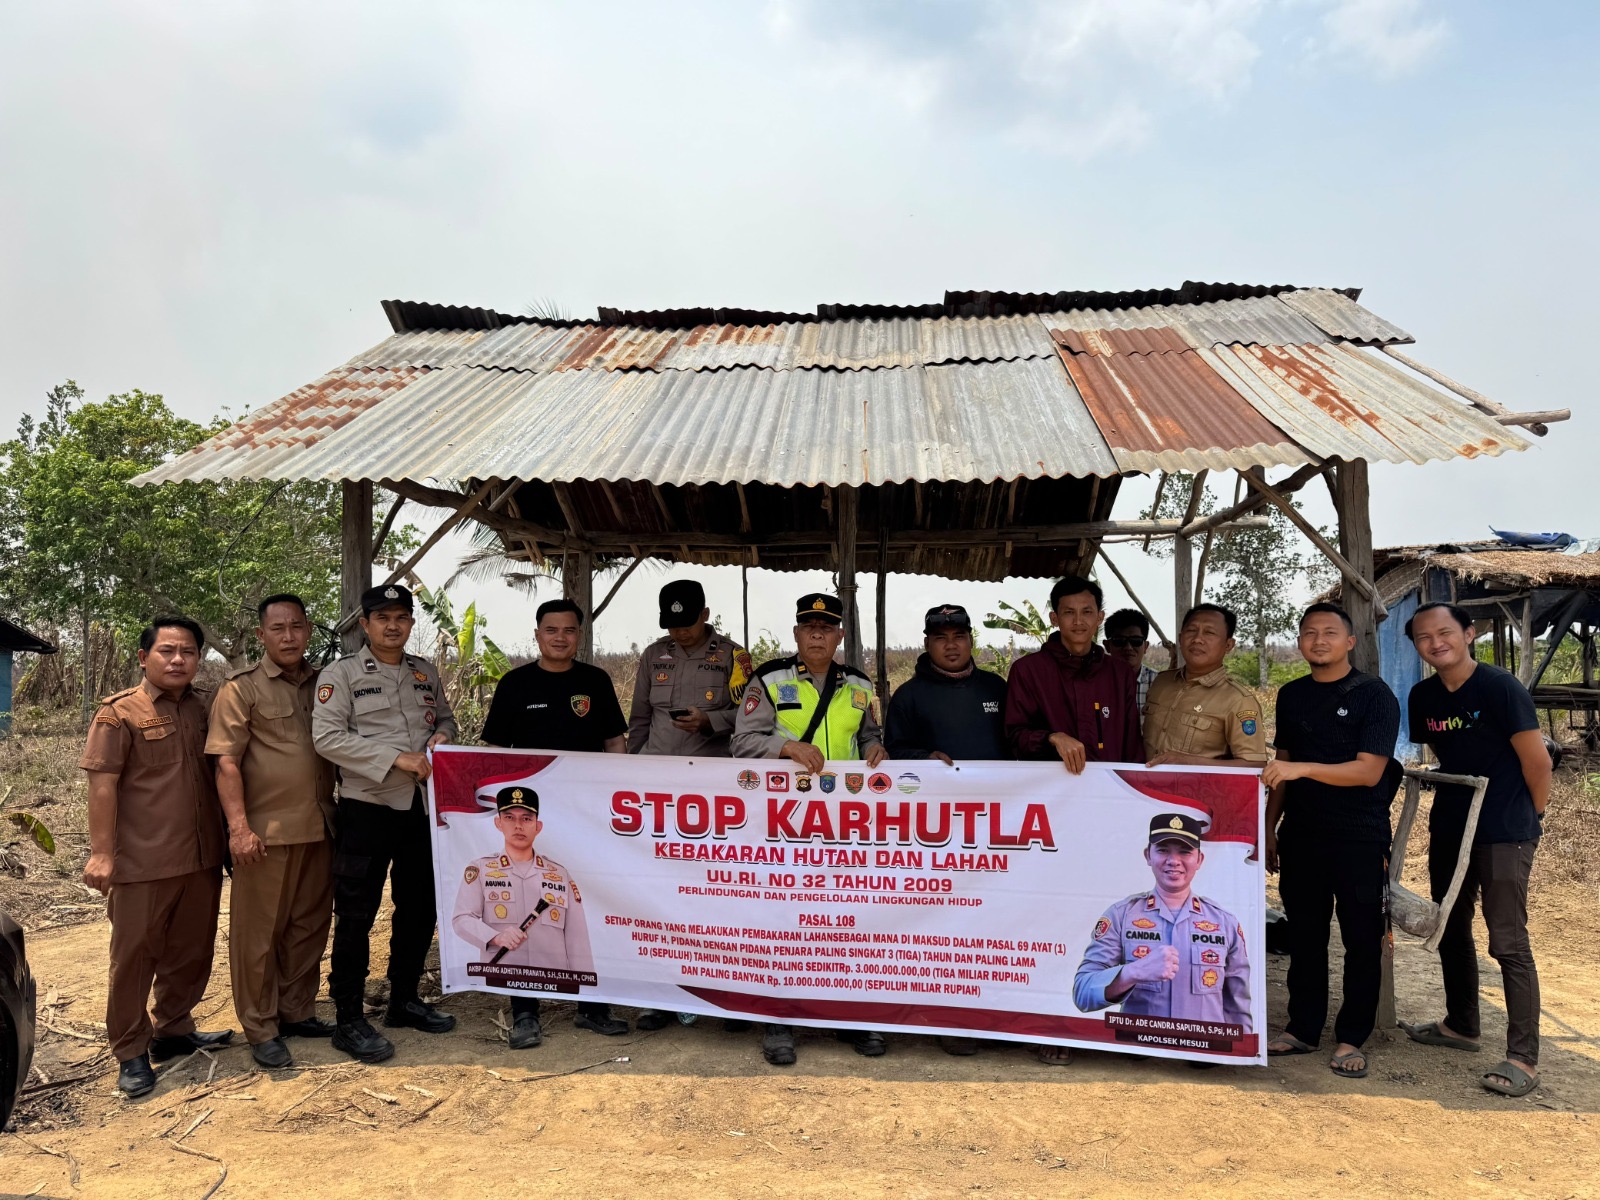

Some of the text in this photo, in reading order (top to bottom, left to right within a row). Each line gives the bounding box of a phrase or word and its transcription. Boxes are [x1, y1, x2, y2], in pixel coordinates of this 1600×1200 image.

[353, 687, 382, 698] EKOWILLY
[1426, 717, 1463, 731] Hurley
[609, 791, 1058, 851] STOP KARHUTLA
[654, 841, 1009, 872] KEBAKARAN HUTAN DAN LAHAN
[485, 880, 506, 888] AGUNG
[541, 881, 566, 893] POLRI
[707, 869, 953, 892] UU.RI. NO 32 TAHUN 2009
[678, 885, 983, 907] PERLINDUNGAN DAN PENGELOLAAN LINGKUNGAN HIDUP
[799, 913, 856, 928] PASAL 108
[604, 915, 1067, 956] SETIAP ORANG YANG MELAKUKAN PEMBAKARAN LAHANSEBAGAI MANA DI MAKSUD DALAM PASAL 69 AYAT (1)
[1125, 930, 1161, 942] CANDRA
[1192, 934, 1225, 946] POLRI
[631, 931, 1036, 968] HURUF H, PIDANA DENGAN PIDANA PENJARA PALING SINGKAT 3 (TIGA) TAHUN DAN PALING LAMA
[482, 966, 500, 974] AGUNG
[638, 946, 648, 956] 10
[650, 947, 692, 962] (SEPULUH)
[693, 952, 721, 964] TAHUN
[722, 955, 740, 966] DAN
[741, 957, 770, 969] DENDA
[772, 961, 804, 972] PALING
[855, 963, 931, 979] 3.000.000.000,00
[932, 967, 956, 979] (TIGA
[958, 969, 989, 981] MILIAR
[991, 971, 1030, 985] RUPIAH)
[506, 980, 558, 991] KAPOLRES OKI
[681, 965, 981, 998] DAN PALING BANYAK Rp. 10.000.000.000,00 (SEPULUH MILIAR RUPIAH)
[1108, 1015, 1239, 1036] IPTU Dr. ADE CANDRA SAPUTRA, S.Psi, M.si
[1137, 1034, 1209, 1049] KAPOLSEK MESUJI
